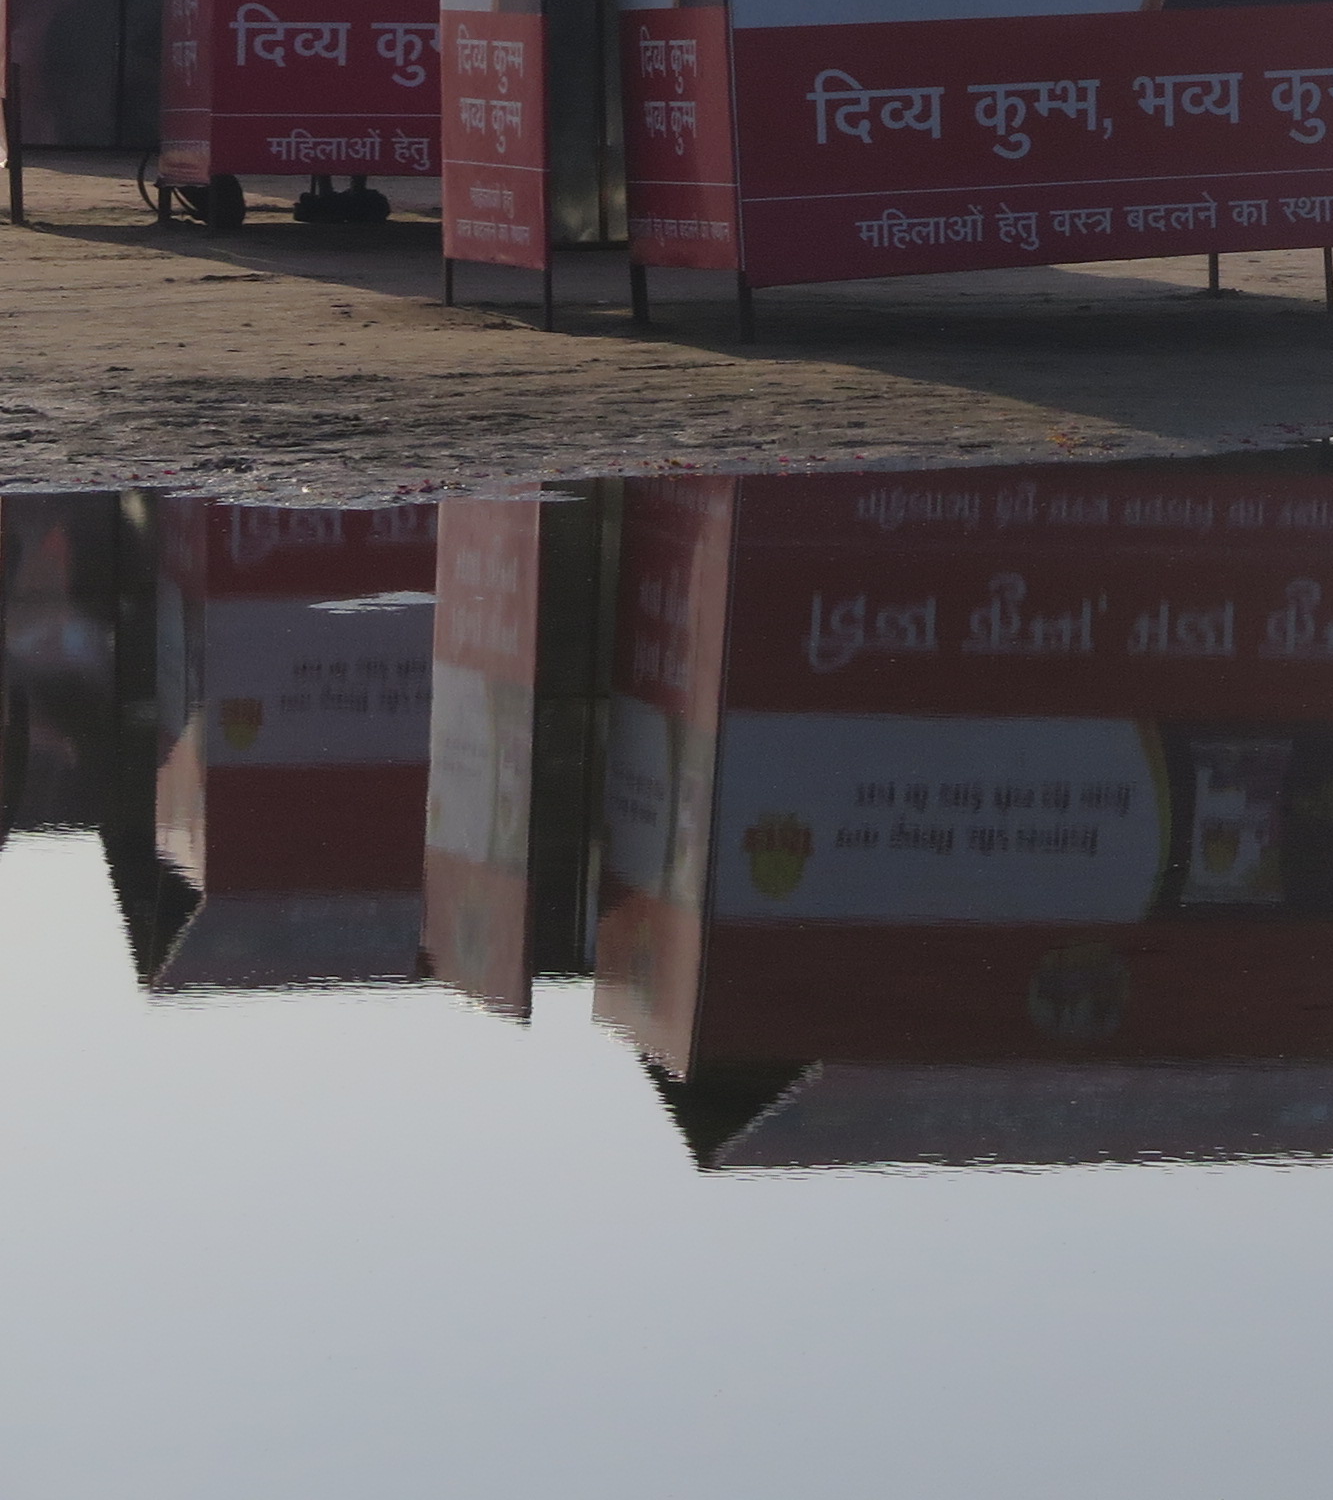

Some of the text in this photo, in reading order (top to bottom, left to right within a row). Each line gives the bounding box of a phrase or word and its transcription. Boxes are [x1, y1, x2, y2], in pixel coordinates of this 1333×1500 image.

[229, 2, 351, 67] दिव्य
[457, 24, 524, 94] दिव्य कुम्भ
[806, 69, 945, 144] दिव्य
[967, 79, 1114, 159] कुम्भ,
[1131, 72, 1244, 127] भव्य
[267, 129, 430, 171] महिलाओं हेतु
[855, 206, 985, 249] महिलाओं
[996, 207, 1040, 250] हेतु
[1050, 207, 1113, 236] वस्त्र
[1124, 192, 1218, 232] बदलने
[1231, 199, 1269, 226] का
